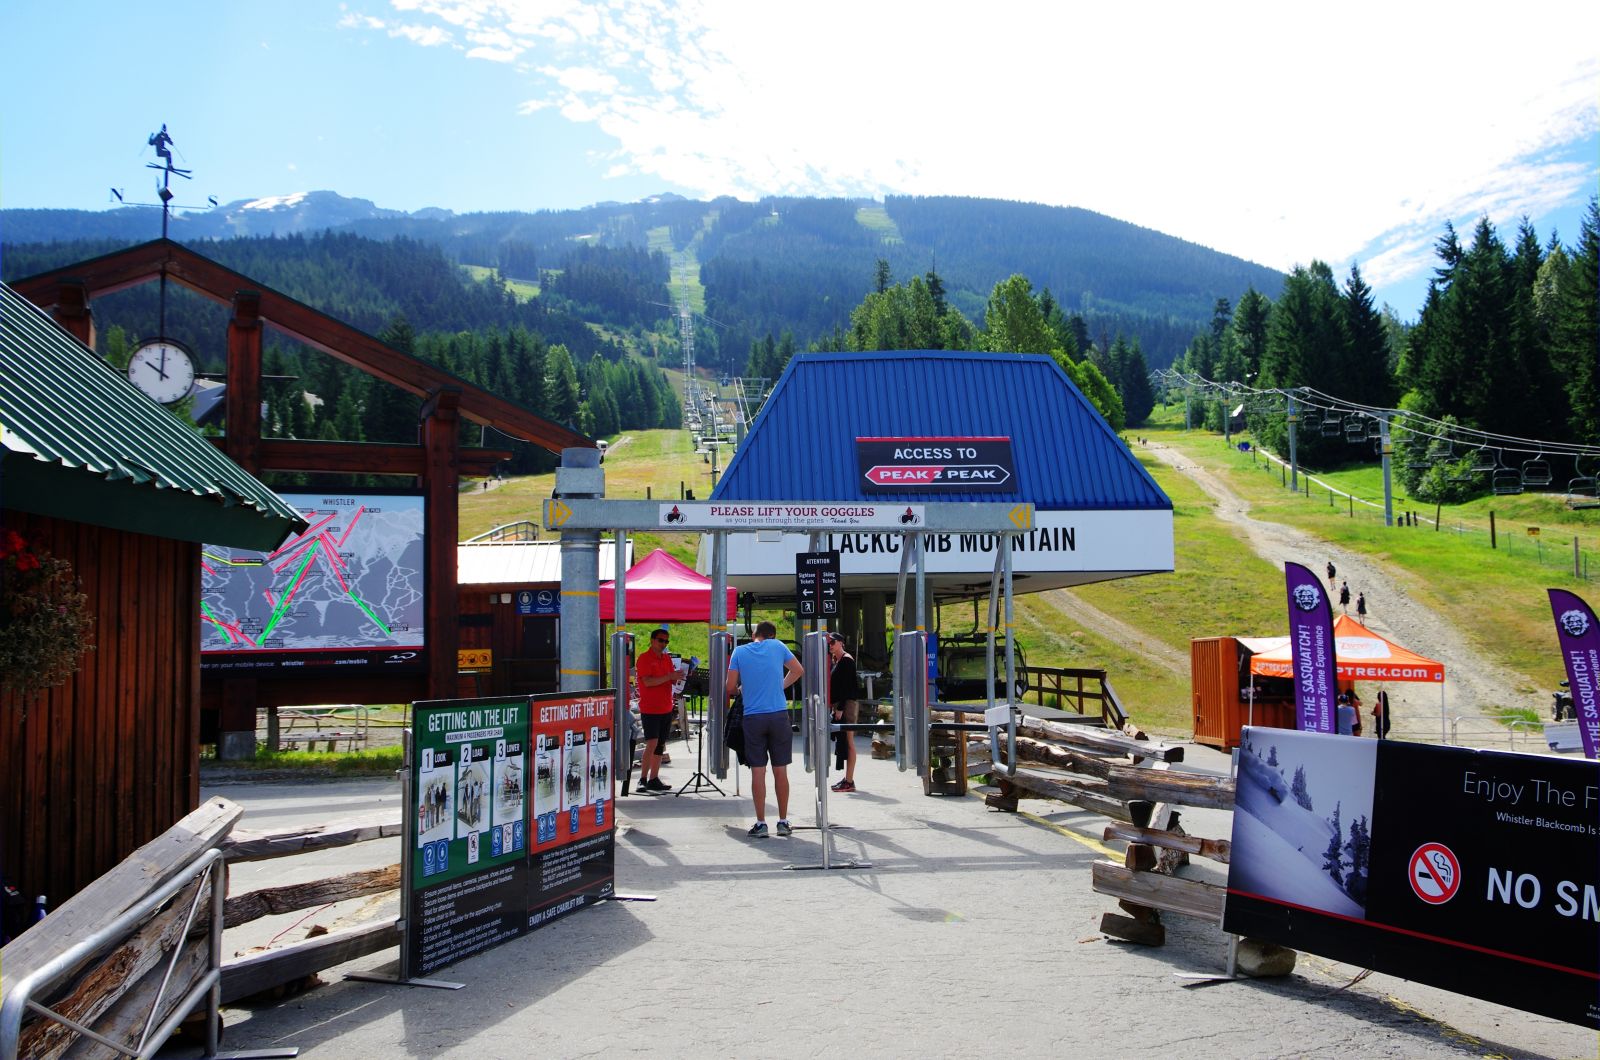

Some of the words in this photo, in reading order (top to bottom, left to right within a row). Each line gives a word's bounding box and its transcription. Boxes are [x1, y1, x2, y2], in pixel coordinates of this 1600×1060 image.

[894, 448, 952, 460] ACCESS
[956, 448, 977, 459] TO
[880, 470, 928, 480] PEAK
[933, 470, 942, 479] 2
[948, 470, 996, 478] PEAK
[322, 498, 356, 506] WHISTLER
[710, 506, 754, 516] PLEASE
[758, 507, 782, 516] LIFT
[784, 507, 818, 516] YOUR
[821, 507, 875, 516] GOGGLES
[766, 517, 792, 525] through
[828, 532, 952, 553] LACKCMB
[960, 528, 1076, 552] MONTAIN
[1314, 626, 1325, 667] Experience
[1298, 624, 1314, 694] SASQUATCH!
[1318, 670, 1328, 696] Zipline
[1570, 650, 1598, 719] SASQUATCH!
[540, 704, 568, 723] GETTING
[570, 703, 582, 719] OFF
[583, 702, 594, 718] THE
[596, 700, 608, 716] LIFT
[1304, 696, 1316, 716] THE
[1320, 698, 1329, 731] Ultimate
[428, 712, 467, 732] GETTING
[470, 710, 482, 728] ON
[484, 709, 500, 726] THE
[502, 708, 519, 724] LIFT
[446, 733, 463, 741] MAXIMUM
[466, 730, 487, 738] PASSENGERS
[538, 738, 543, 750] 4
[567, 734, 571, 746] 5
[592, 730, 596, 742] 6
[1587, 722, 1600, 746] THE
[426, 752, 430, 768] 1
[434, 752, 446, 762] LOOK
[464, 748, 468, 762] 2
[472, 748, 483, 758] LOAD
[498, 743, 504, 758] 3
[506, 744, 520, 752] LOWER
[1464, 771, 1524, 804] Enjoy
[1530, 779, 1576, 806] The
[1496, 812, 1534, 826] Whistler
[1536, 818, 1586, 833] Blackcomb
[1588, 825, 1596, 835] Is
[1487, 867, 1541, 908] NO
[529, 912, 542, 926] ENJOY
[542, 911, 546, 919] A
[547, 906, 556, 917] SAFE
[557, 899, 576, 914] CHAIRLIFT
[576, 895, 585, 905] RIDE
